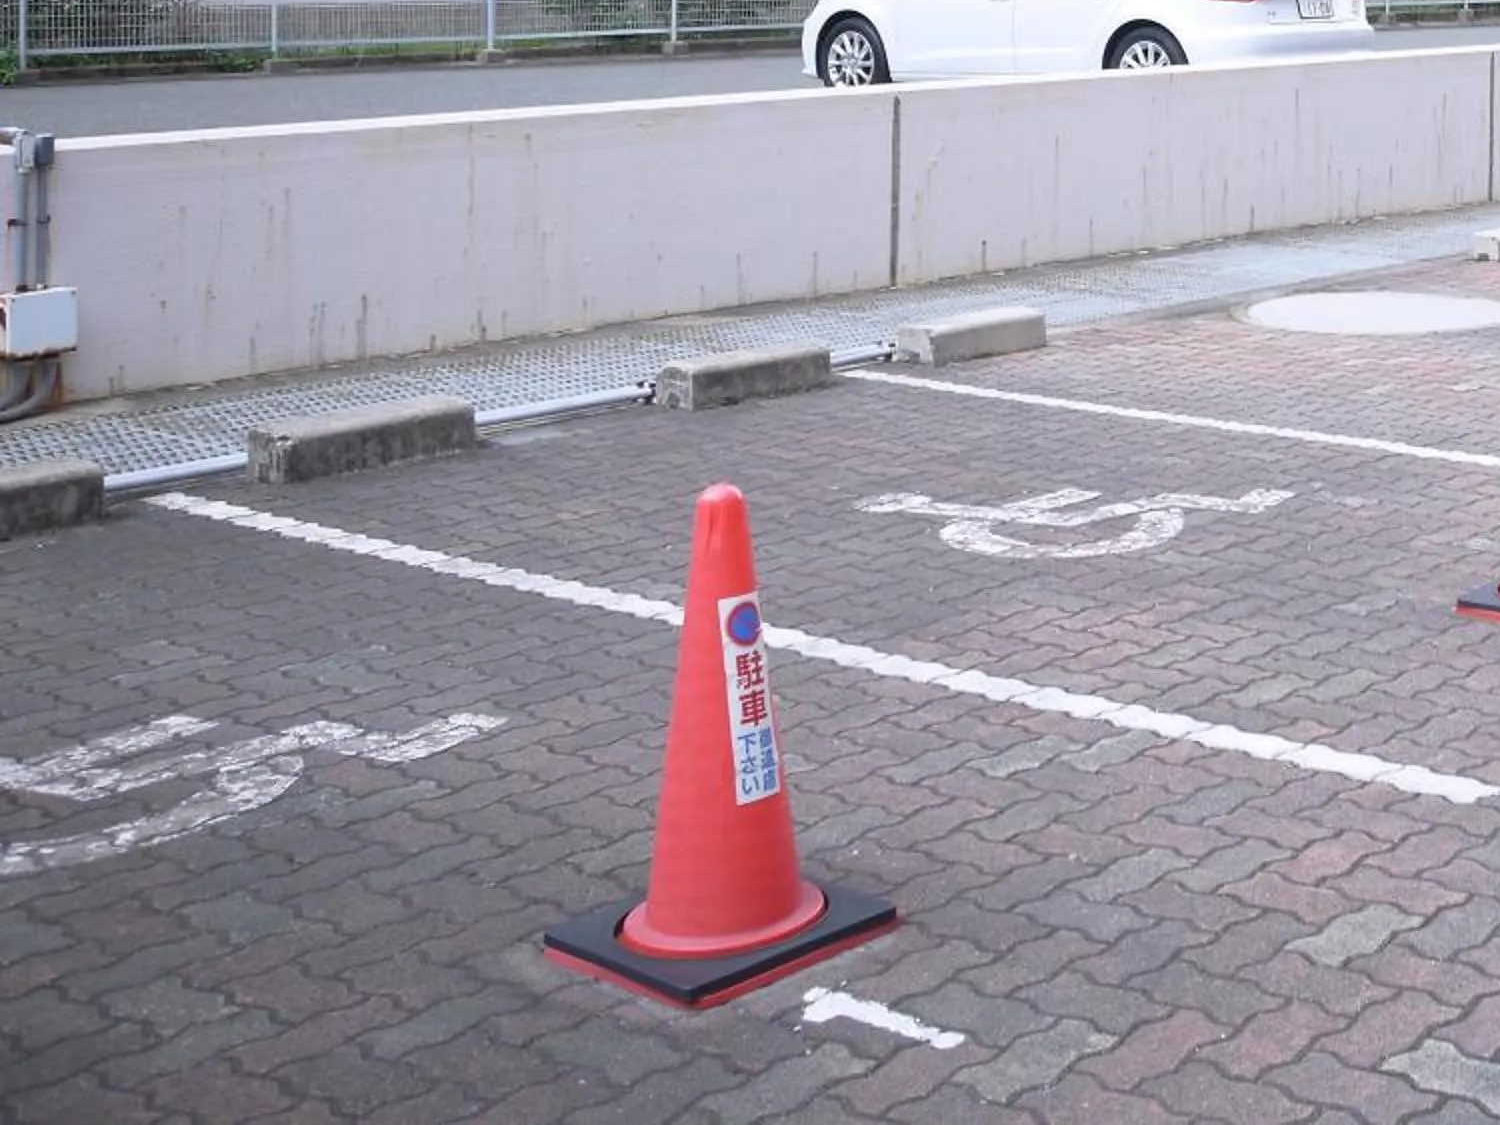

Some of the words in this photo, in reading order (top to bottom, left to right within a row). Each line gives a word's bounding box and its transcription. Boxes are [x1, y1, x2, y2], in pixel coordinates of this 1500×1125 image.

[736, 650, 768, 726] 駐車
[738, 733, 759, 794] 下さい
